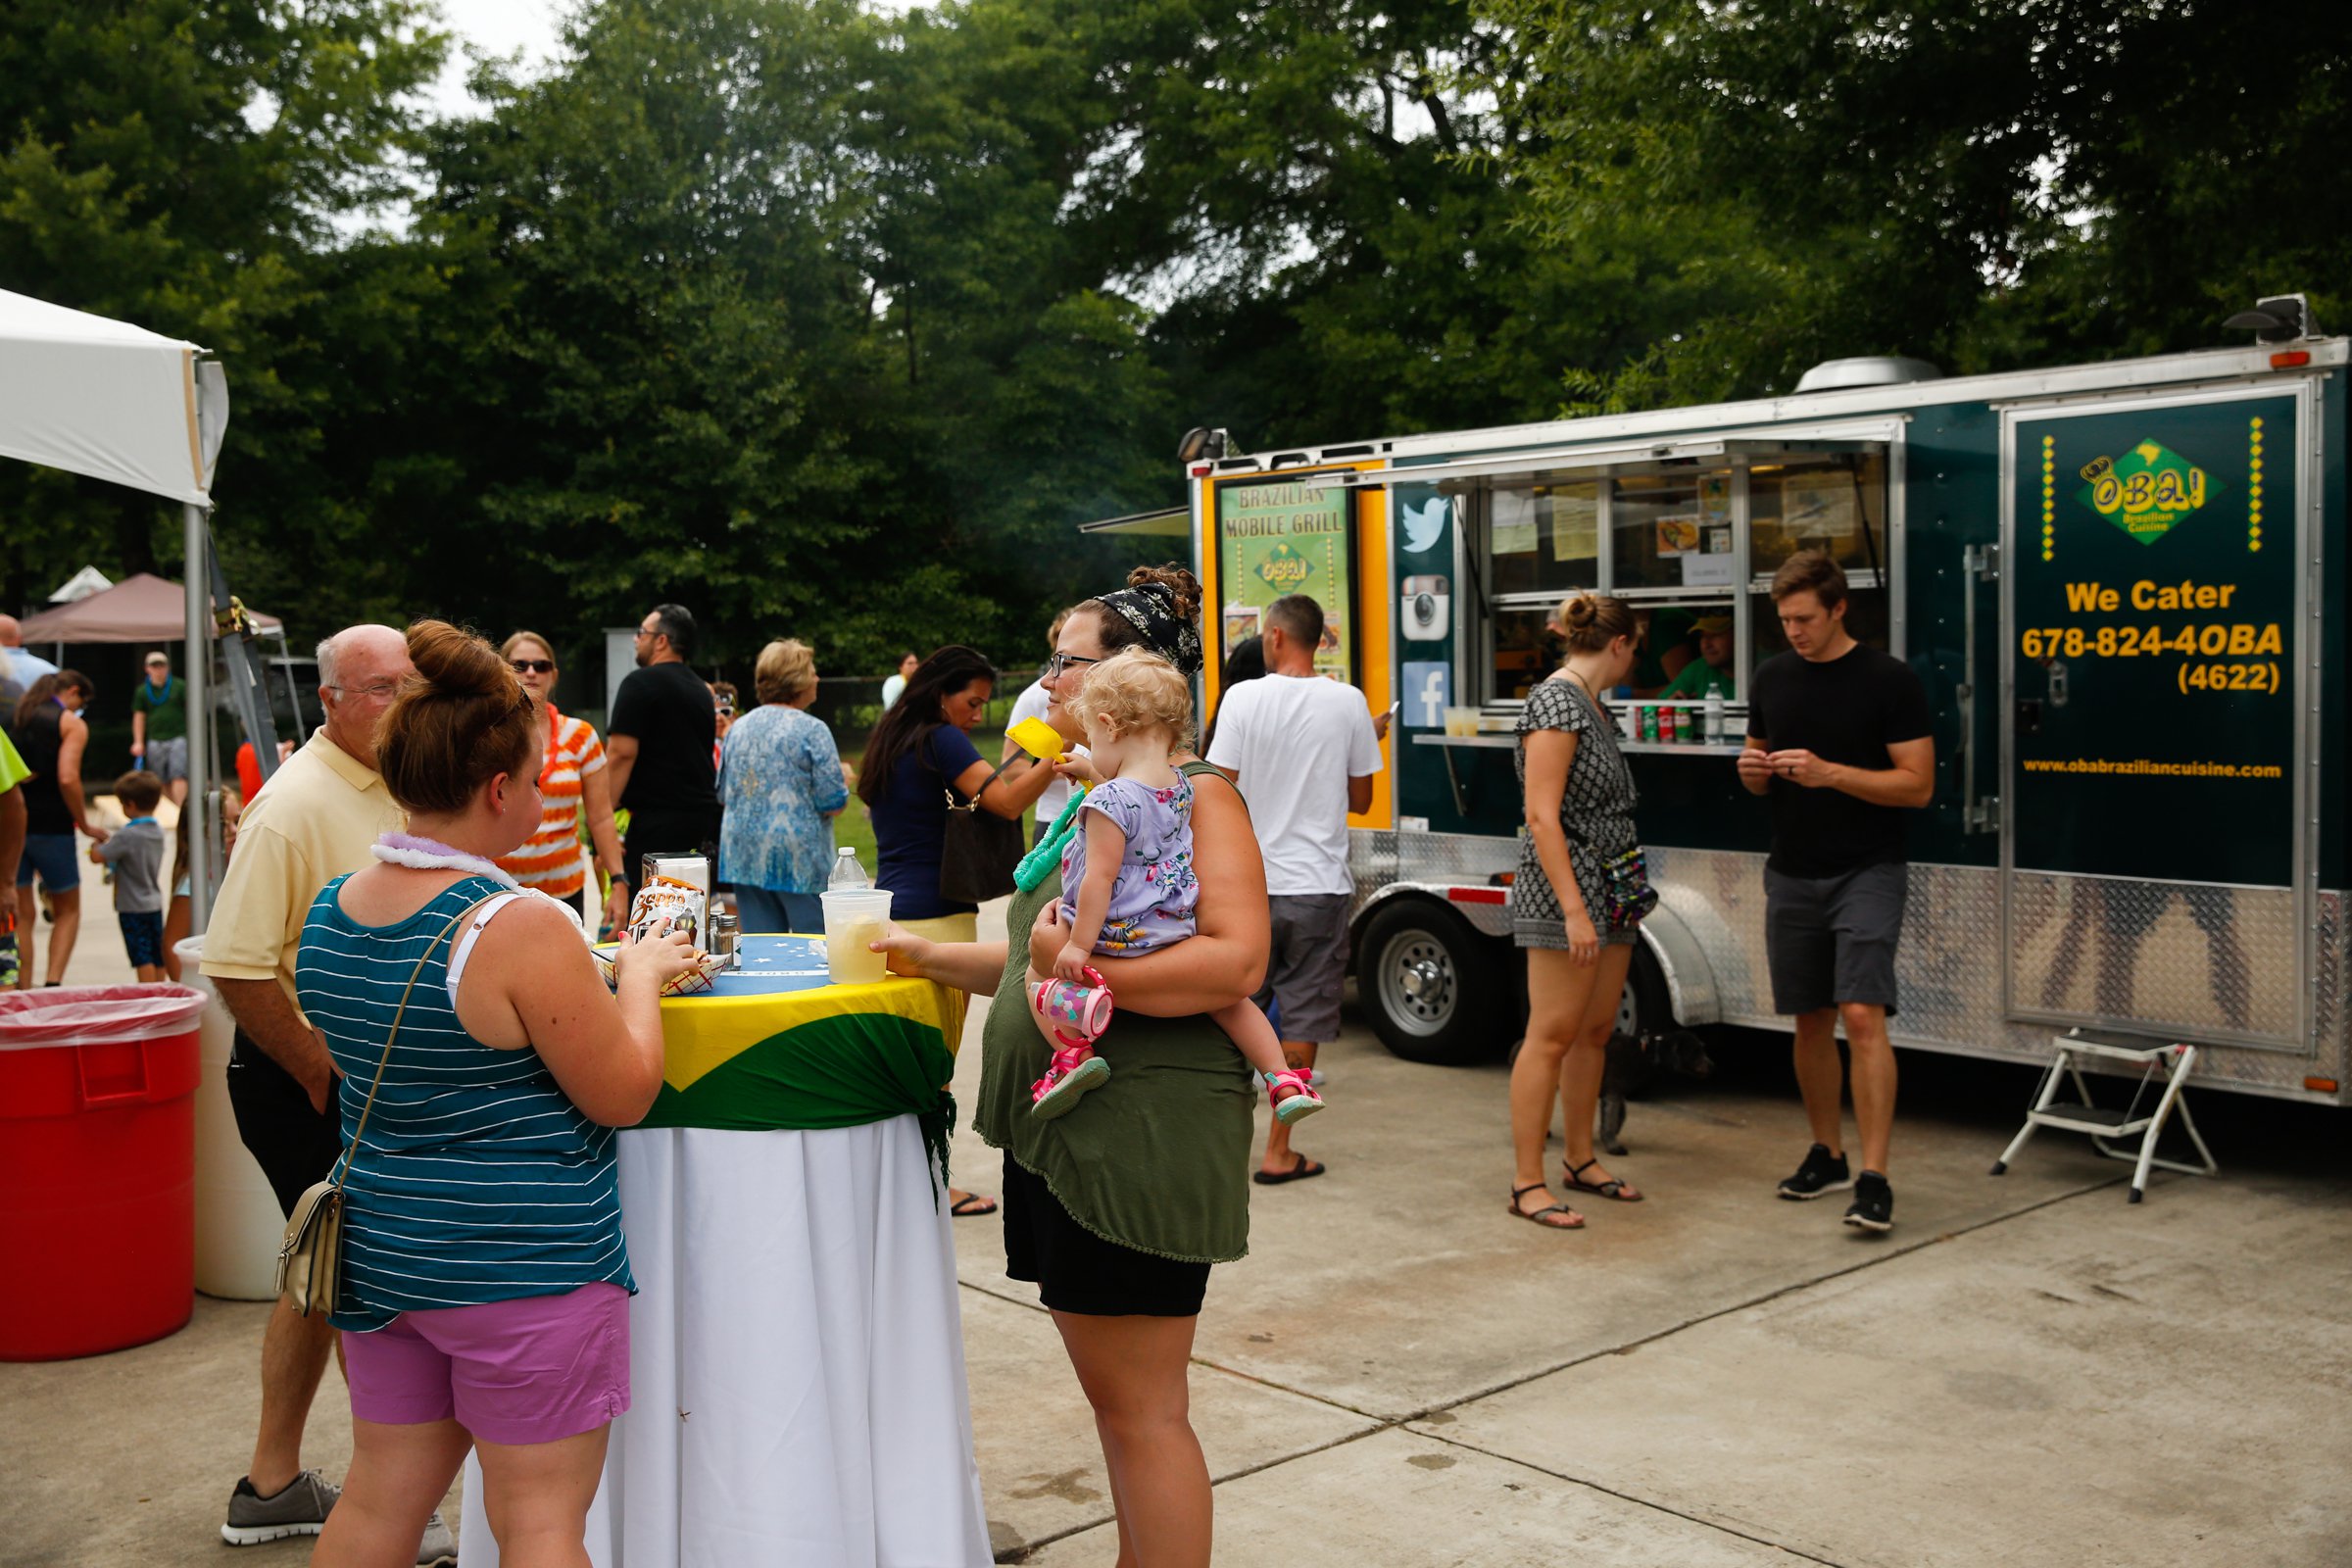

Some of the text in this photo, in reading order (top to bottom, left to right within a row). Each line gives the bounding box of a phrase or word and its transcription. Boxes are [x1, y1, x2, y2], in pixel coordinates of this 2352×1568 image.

[1239, 485, 1325, 509] BRAZILIAN
[1226, 512, 1343, 538] MOBILE GRILL
[2065, 579, 2237, 612] We Cater
[2022, 623, 2282, 658] 678-824-4OBA
[2178, 662, 2281, 695] (4622)
[2023, 758, 2282, 778] www.obabraziliancuisine.com
